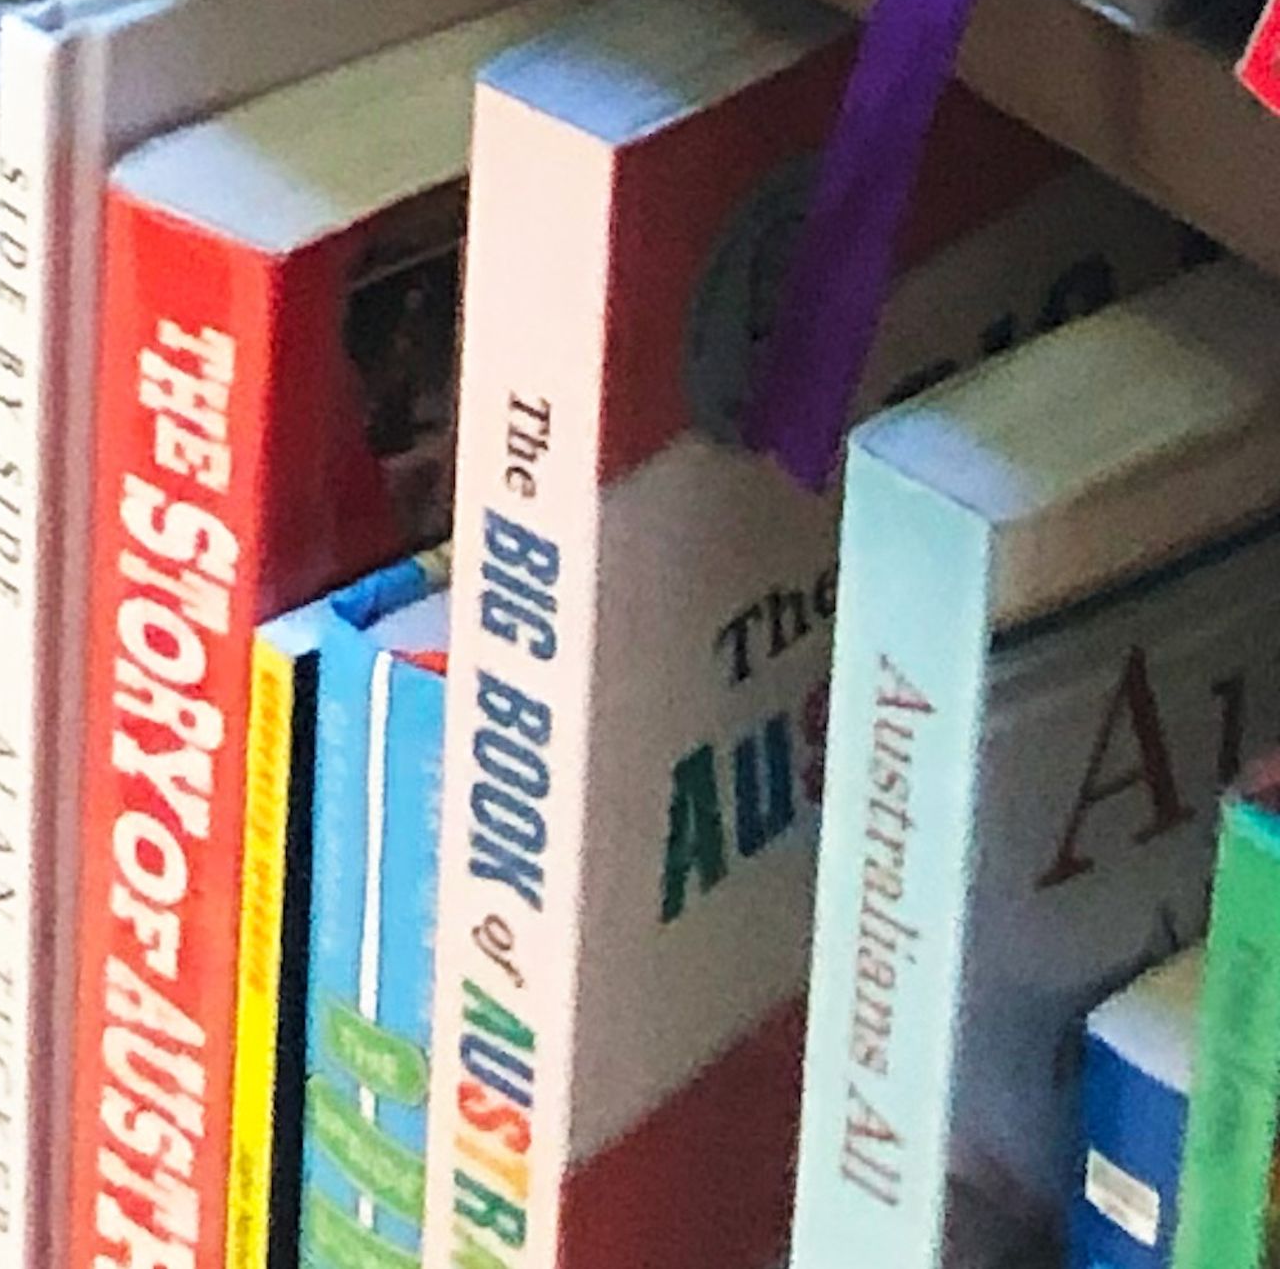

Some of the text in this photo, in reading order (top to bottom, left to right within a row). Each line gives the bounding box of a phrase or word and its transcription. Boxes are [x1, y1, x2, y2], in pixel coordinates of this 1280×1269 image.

[138, 318, 236, 495] THE
[504, 390, 553, 500] The
[111, 472, 241, 841] STORY
[479, 506, 562, 662] BIG
[468, 667, 554, 913] BOOK
[111, 810, 189, 981] OF
[471, 911, 528, 990] of
[840, 652, 939, 1208] Australians All
